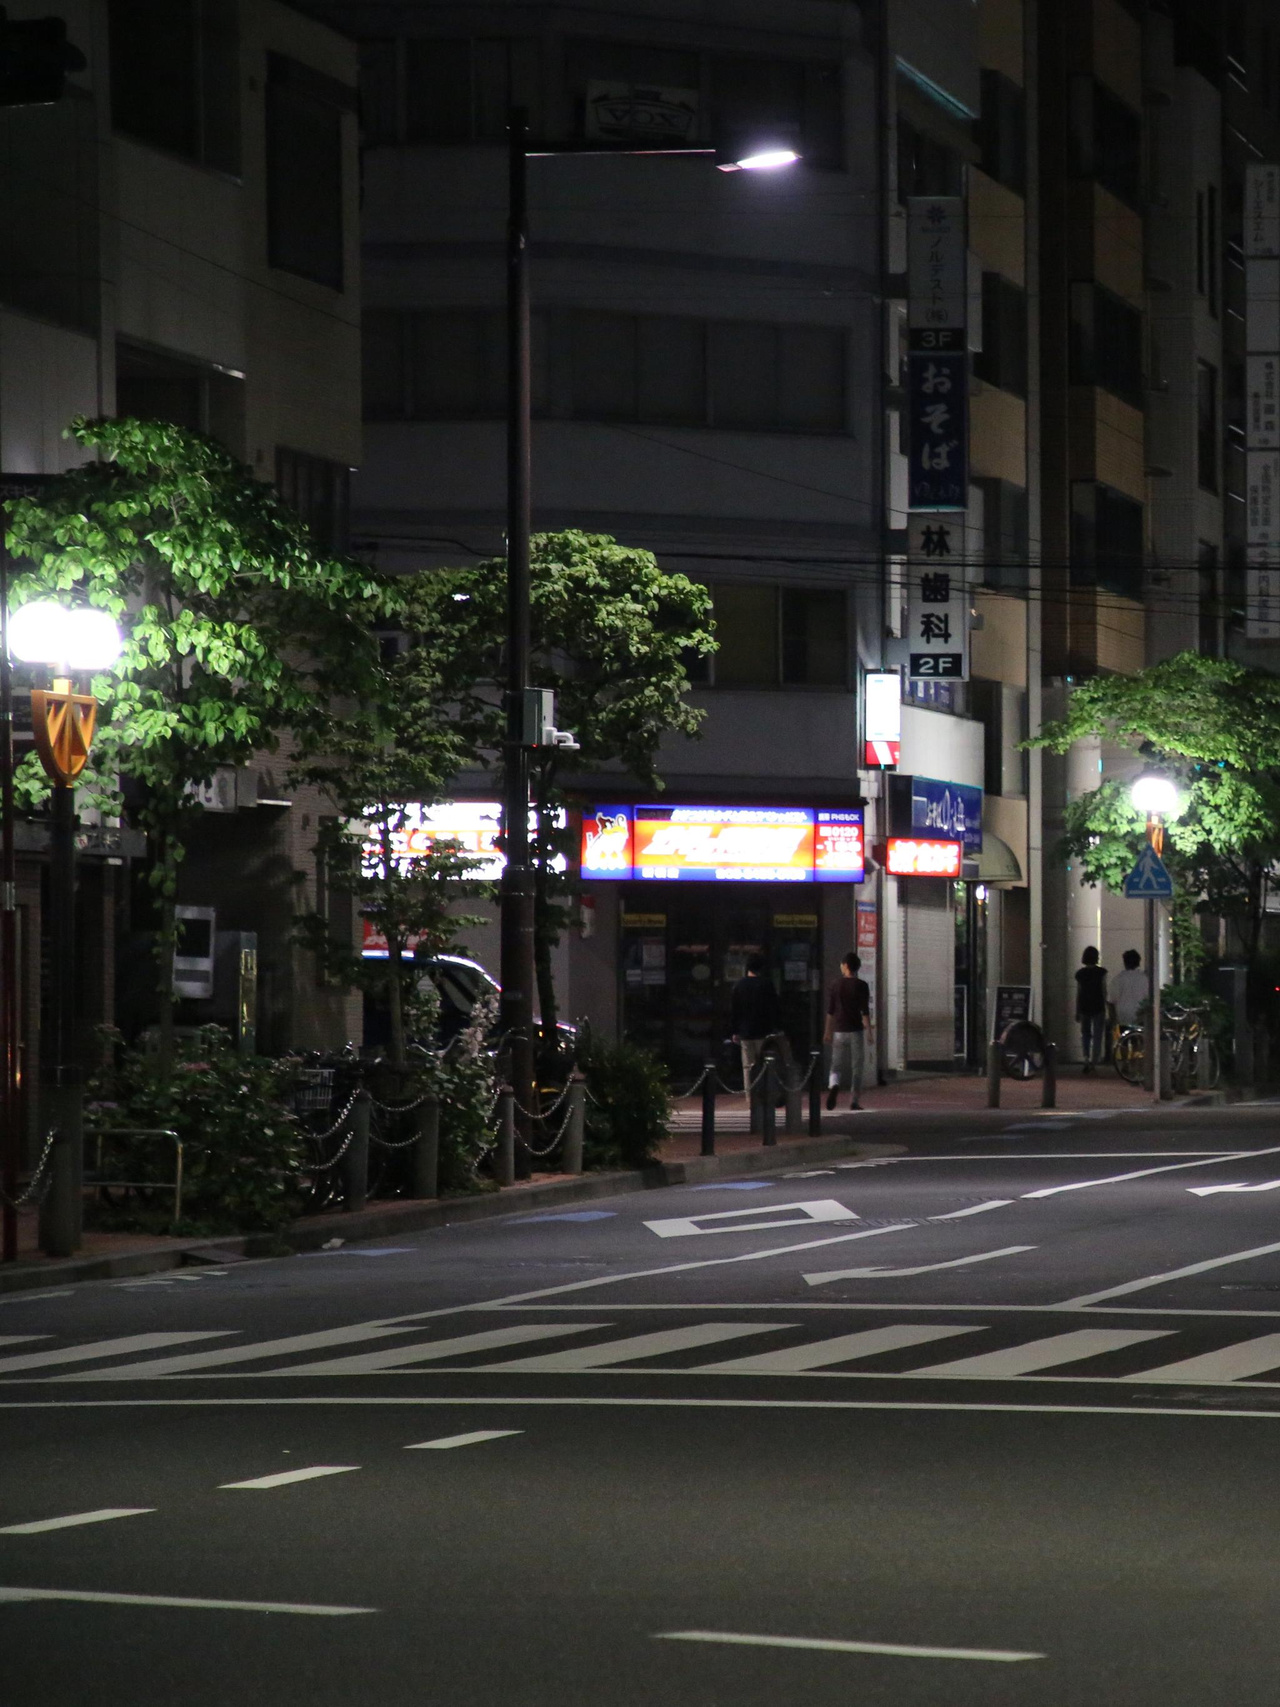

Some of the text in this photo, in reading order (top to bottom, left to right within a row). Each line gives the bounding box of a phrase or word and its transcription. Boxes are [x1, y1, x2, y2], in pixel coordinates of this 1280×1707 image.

[920, 331, 952, 348] 3F
[920, 361, 959, 471] おそば
[921, 525, 951, 644] 林歯科
[919, 658, 953, 673] 2F
[832, 826, 859, 838] 0120
